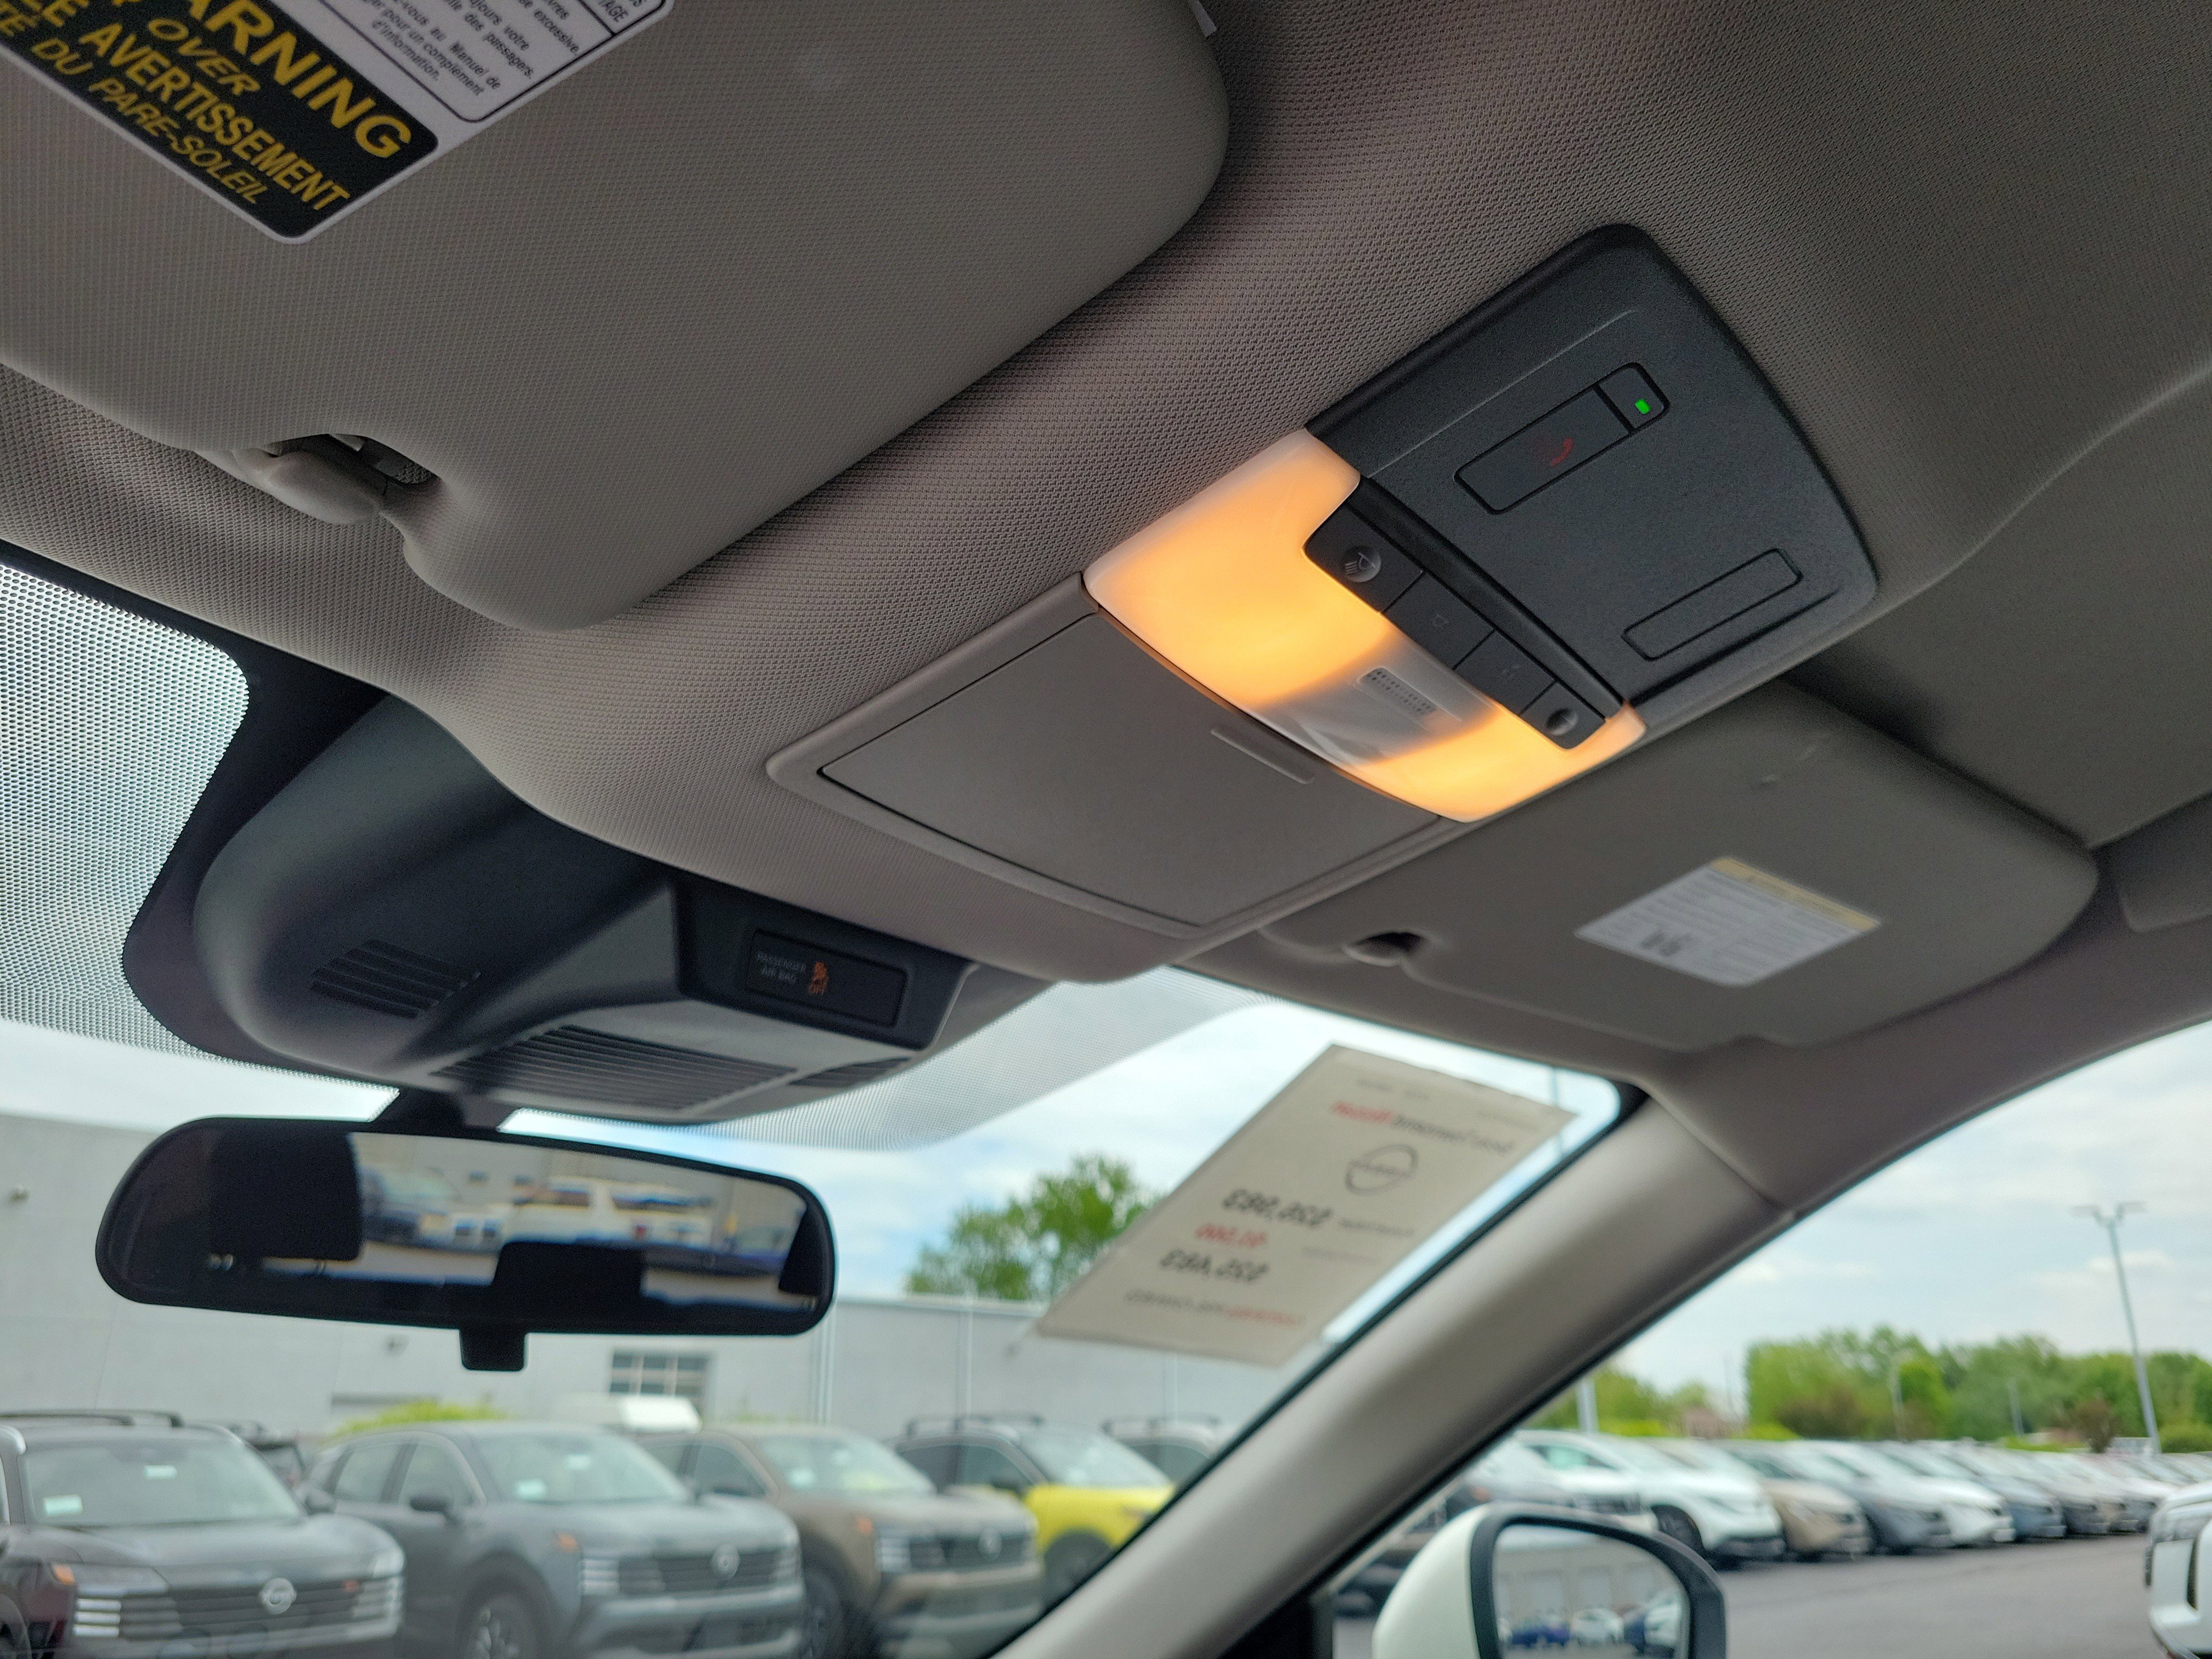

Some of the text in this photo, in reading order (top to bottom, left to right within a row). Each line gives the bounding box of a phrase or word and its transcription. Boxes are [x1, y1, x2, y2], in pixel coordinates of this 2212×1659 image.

[148, 18, 261, 96] OVER
[381, 8, 411, 32] pour
[408, 29, 425, 44] un
[430, 26, 447, 42] au
[449, 41, 490, 77] Manuel
[486, 76, 502, 90] de
[464, 13, 485, 32] des
[484, 31, 534, 80] passagers.
[504, 25, 530, 52] votre
[534, 9, 580, 56] excessive.
[32, 38, 94, 75] DU
[88, 77, 268, 204] PARE-SOLEIL
[78, 22, 351, 211] AVERTISSEMENT
[760, 965, 797, 985] AIR BAG
